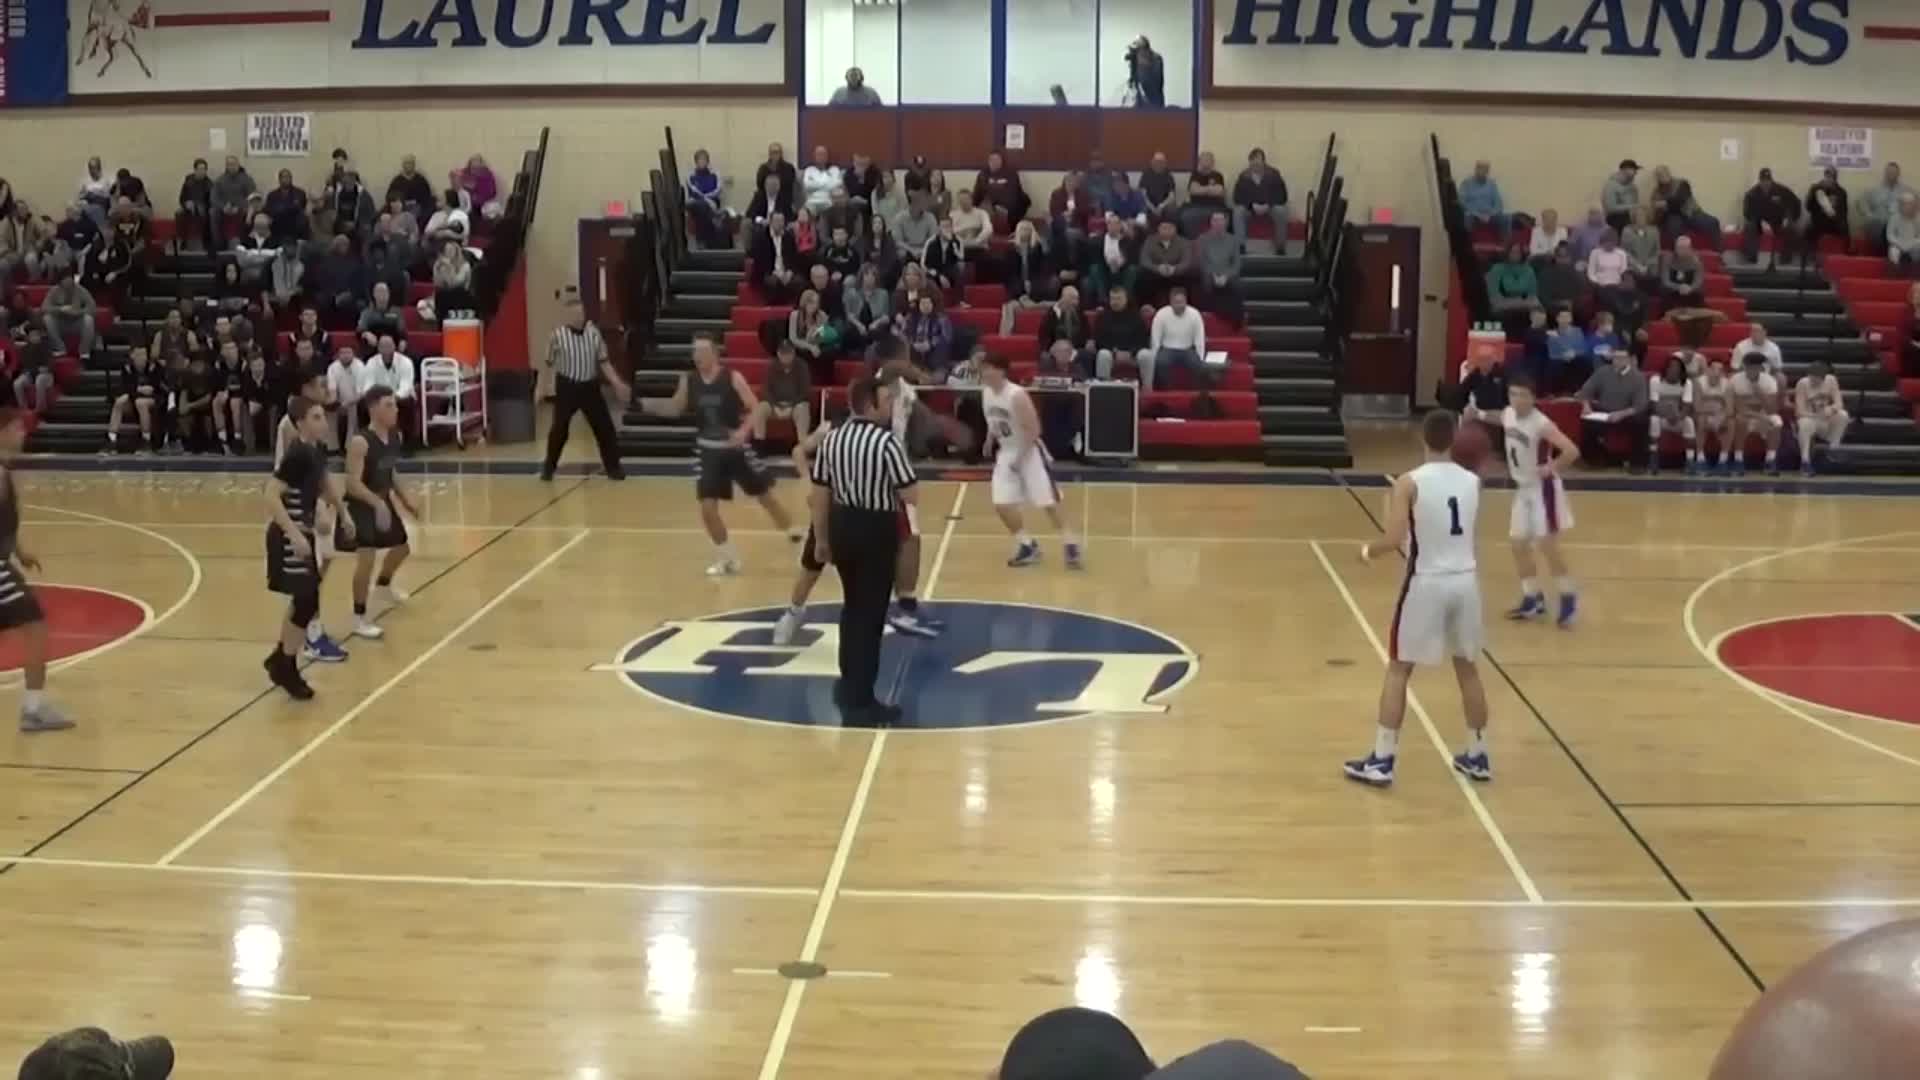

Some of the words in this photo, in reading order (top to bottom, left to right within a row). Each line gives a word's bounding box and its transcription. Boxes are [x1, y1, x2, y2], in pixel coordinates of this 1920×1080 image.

[351, 0, 777, 48] LAUREL
[1222, 0, 1849, 65] HIGHLANDS
[1447, 496, 1463, 535] 1
